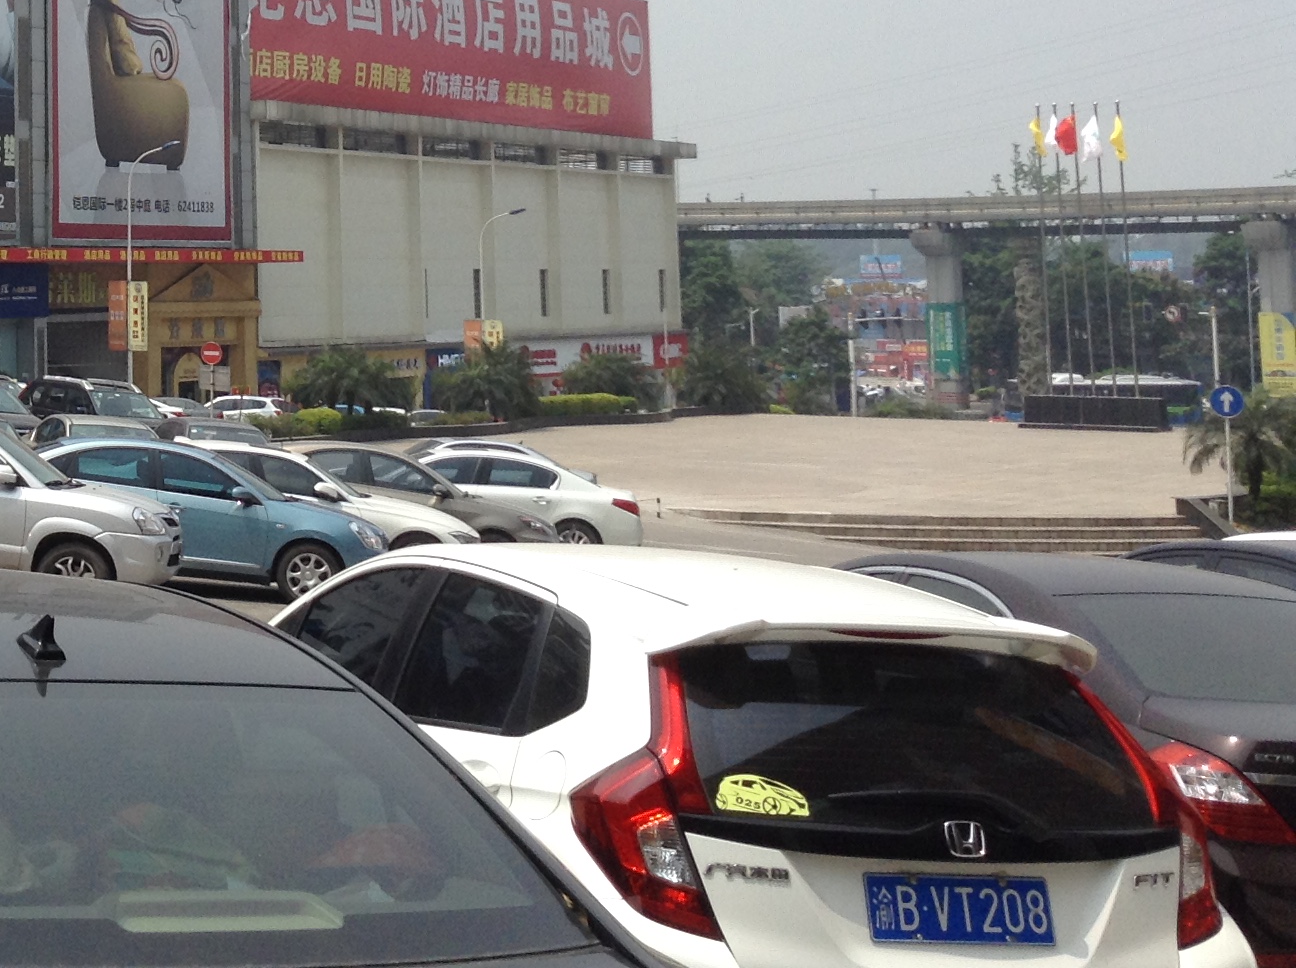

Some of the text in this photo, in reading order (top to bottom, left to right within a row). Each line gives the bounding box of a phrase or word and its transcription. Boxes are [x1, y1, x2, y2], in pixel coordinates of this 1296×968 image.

[353, 60, 412, 95] 日用陶瓷
[421, 69, 502, 104] 灯饰精品长廊
[504, 80, 553, 112] 家居饰品
[735, 796, 761, 810] 025
[1133, 872, 1175, 889] FIT
